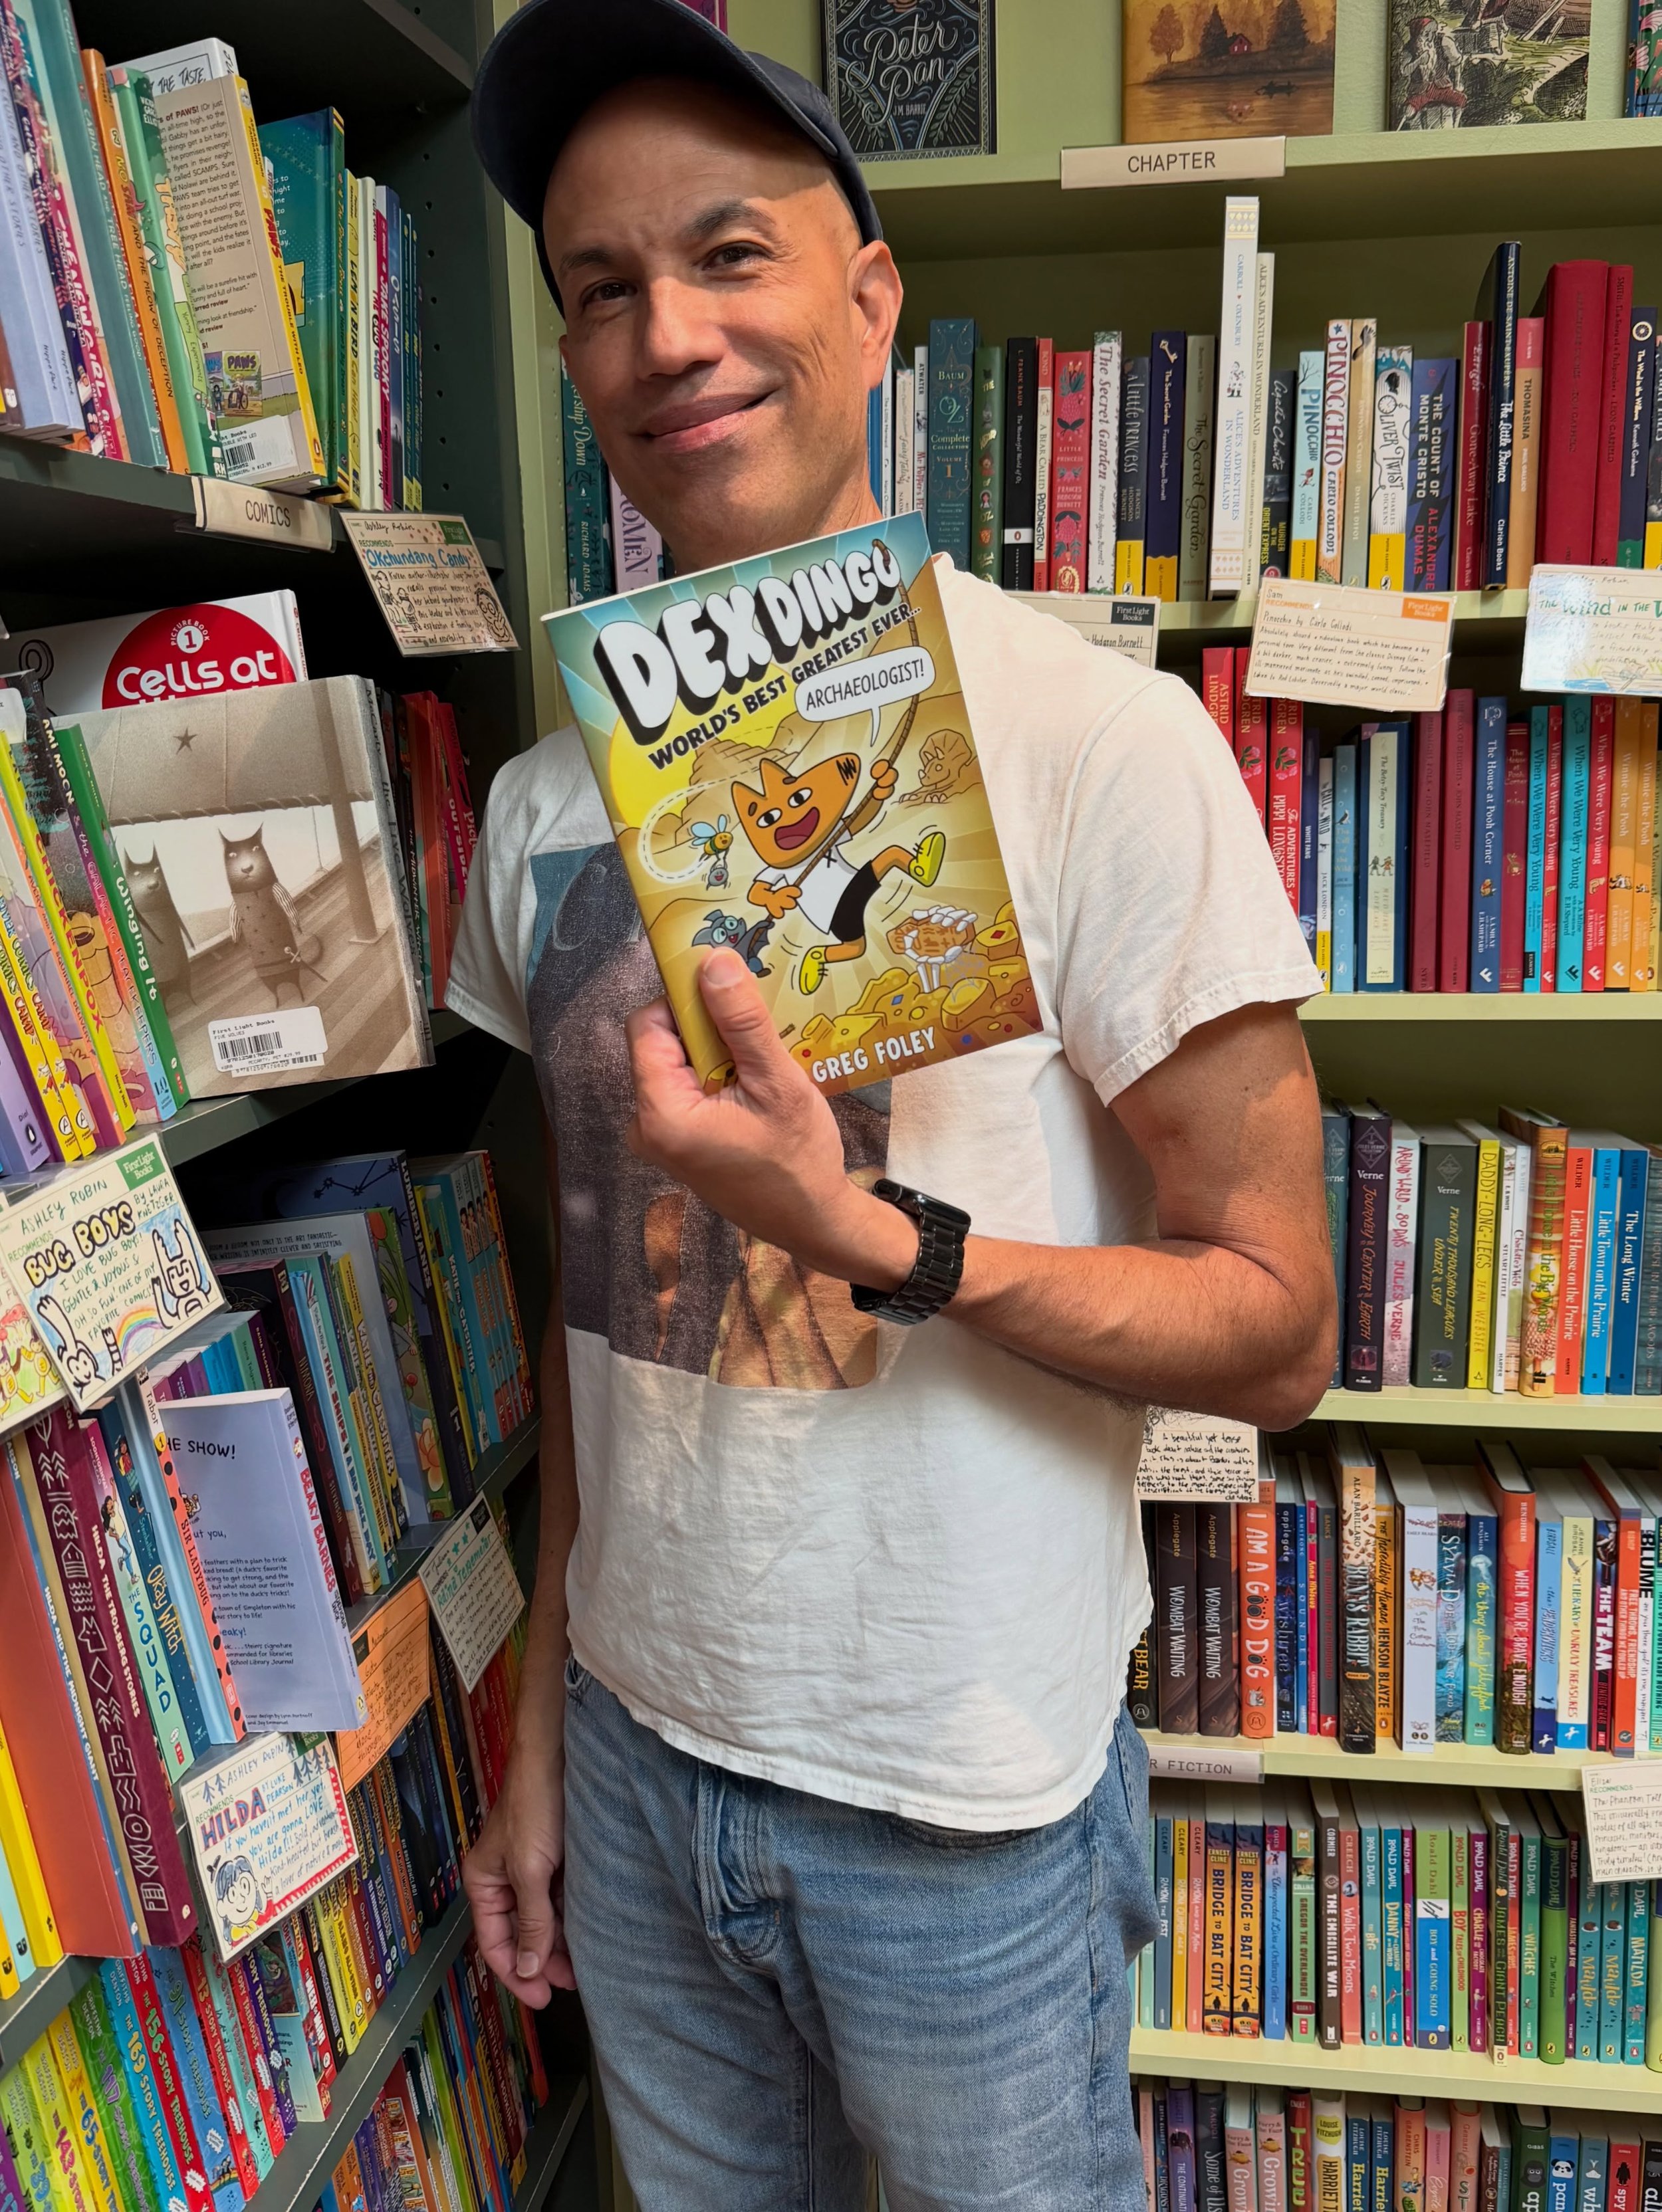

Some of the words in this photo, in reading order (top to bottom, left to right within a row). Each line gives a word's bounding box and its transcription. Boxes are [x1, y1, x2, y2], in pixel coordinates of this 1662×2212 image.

[846, 13, 958, 92] Peter
[158, 76, 176, 94] THE
[862, 57, 958, 126] Pan
[166, 112, 174, 122] of
[176, 106, 199, 118] PAWS!
[212, 100, 223, 110] just
[1128, 152, 1216, 173] CHAPTER
[263, 208, 283, 259] PAWS
[133, 225, 142, 250] AND
[138, 255, 148, 276] THE
[144, 278, 156, 314] MEOW
[152, 318, 160, 334] OF
[156, 336, 174, 398] DECEPTION
[281, 284, 295, 328] TROUBLE
[291, 330, 300, 352] WITH
[380, 276, 389, 323] JAKE
[381, 324, 390, 401] SPOOKY
[938, 371, 965, 380] BAUM
[1098, 346, 1114, 372] The
[1098, 375, 1114, 426] Secret
[1324, 334, 1350, 466] PINOCCHIO
[1419, 394, 1430, 443] MONTE
[1433, 393, 1443, 421] THE
[1499, 400, 1513, 422] The
[1521, 379, 1533, 441] THOMASINA
[930, 434, 970, 445] Complete
[1225, 419, 1232, 431] IN
[1235, 409, 1244, 453] ALICE'S
[1300, 388, 1322, 462] PINOCCHIO
[1377, 394, 1396, 449] OLIVER
[1498, 423, 1512, 451] Little
[573, 427, 592, 466] Down
[1038, 434, 1048, 454] BEAR
[1097, 429, 1112, 481] Garden
[1431, 423, 1443, 476] COUNT
[945, 465, 953, 478] 1
[1038, 457, 1047, 490] CALLED
[1222, 435, 1231, 510] WONDERLAND
[1231, 456, 1243, 522] ADVENTURES
[1383, 446, 1405, 491] TWIST
[1416, 445, 1428, 499] CRISTO
[1429, 477, 1440, 497] OF
[1496, 453, 1512, 484] Prince
[245, 499, 291, 528] COMICS
[438, 548, 470, 569] Candy
[1413, 524, 1425, 575] DUMAS
[1426, 508, 1439, 590] ALEXANDRE
[171, 619, 193, 646] PICTURE
[194, 620, 210, 642] BOOK
[184, 630, 197, 649] 1
[1263, 611, 1292, 625] Pinocchio
[1296, 614, 1303, 626] by
[1309, 616, 1327, 627] Carlo
[1330, 619, 1352, 631] Collodi
[593, 586, 773, 746] DEX
[755, 539, 902, 665] DINGO
[116, 661, 225, 700] Cells
[229, 650, 278, 684] at
[648, 703, 741, 771] WORLD'S
[741, 679, 788, 719] BEST
[790, 629, 869, 687] GREATEST
[871, 604, 921, 639] EVER...
[805, 660, 925, 712] ARCHAEOLOGIST!
[1219, 683, 1229, 724] ASTRID
[1487, 739, 1497, 756] The
[1486, 758, 1498, 790] House
[1486, 805, 1495, 832] Pooh
[1487, 792, 1494, 803] at
[1485, 835, 1494, 865] Corner
[34, 832, 102, 1034] CHICKENPOX
[116, 876, 148, 969] Winging
[146, 967, 159, 1001] It
[212, 1026, 231, 1035] First
[235, 1022, 254, 1031] Light
[812, 1048, 869, 1083] GREG
[874, 1026, 936, 1064] FOLEY
[1357, 1170, 1384, 1180] Verne
[21, 1201, 66, 1235] ASHLEY
[70, 1179, 108, 1205] ROBIN
[402, 1159, 431, 1290] LUMBERJANES
[1598, 1210, 1612, 1239] Little
[7, 1230, 54, 1262] RECOMMENDS
[23, 1239, 75, 1289] BUG
[72, 1201, 136, 1258] BOYS
[1597, 1241, 1609, 1268] Town
[1594, 1283, 1607, 1301] the
[1596, 1270, 1605, 1281] on
[1591, 1303, 1607, 1339] Prairie
[187, 1440, 236, 1460] SHOW!
[299, 1468, 320, 1523] BEAKY
[313, 1525, 336, 1593] BARNES
[1246, 1529, 1268, 1557] AM
[181, 1519, 193, 1543] SIR
[188, 1543, 210, 1608] LADYBUG
[1246, 1561, 1268, 1574] A
[1514, 1569, 1529, 1599] WHEN
[1639, 1537, 1655, 1599] BLUME
[148, 1564, 168, 1608] Okay
[1598, 1585, 1611, 1610] THE
[90, 1523, 107, 1569] HILDA
[100, 1572, 112, 1598] THE
[106, 1599, 128, 1666] TROLBERG
[120, 1664, 141, 1718] STORIES
[1168, 1585, 1186, 1630] WOMBAT
[1513, 1600, 1529, 1632] YOU'RE
[157, 1606, 179, 1657] Witch
[1513, 1634, 1529, 1665] BRAVE
[1594, 1615, 1613, 1671] TEAM
[132, 1601, 170, 1715] SQUAD
[1133, 1649, 1149, 1692] BEAR
[1169, 1631, 1186, 1678] WAITING
[1510, 1666, 1528, 1706] ENOUGH
[1167, 1760, 1232, 1775] FICTION
[200, 1787, 266, 1851] HILDA
[1211, 1868, 1225, 1918] BRIDGE
[1326, 1894, 1338, 1915] THE
[1211, 1932, 1224, 1958] BAT
[1214, 1921, 1221, 1930] TO
[1326, 1917, 1338, 1967] CHOCOLATE
[1522, 1934, 1536, 1977] WITCHES
[1630, 1937, 1645, 1988] MATILDA
[1210, 1961, 1223, 1993] CITY
[1326, 1969, 1339, 1998] WAR
[142, 1991, 151, 2009] THE
[144, 2009, 174, 2096] 156-STORY
[169, 2096, 194, 2165] TREEHOUSE
